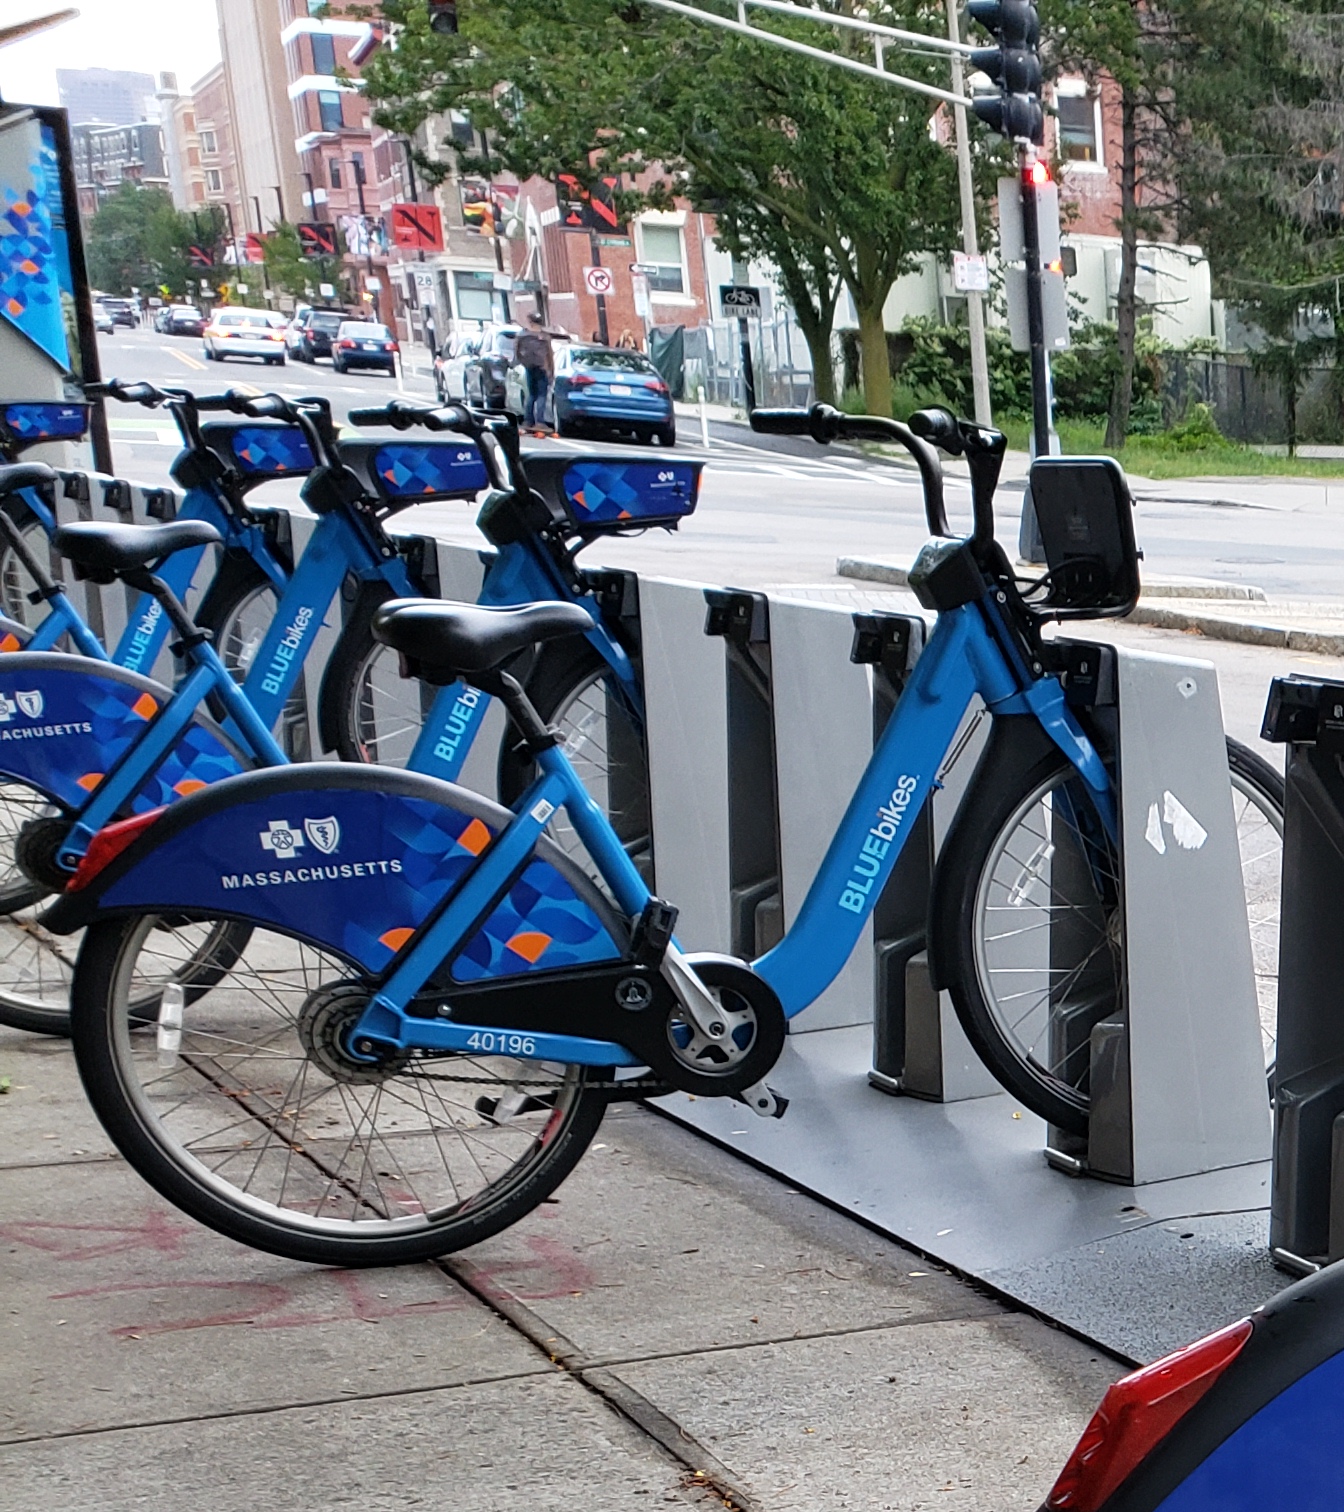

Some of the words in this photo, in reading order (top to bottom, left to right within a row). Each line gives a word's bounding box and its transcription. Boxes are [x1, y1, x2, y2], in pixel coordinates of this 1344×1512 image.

[261, 606, 312, 696] BLUEbikes
[0, 722, 92, 741] ACHUSETTS
[838, 774, 917, 914] BLUEbikes
[221, 859, 403, 889] MASSACHUSETTS
[466, 1032, 536, 1055] 40196
